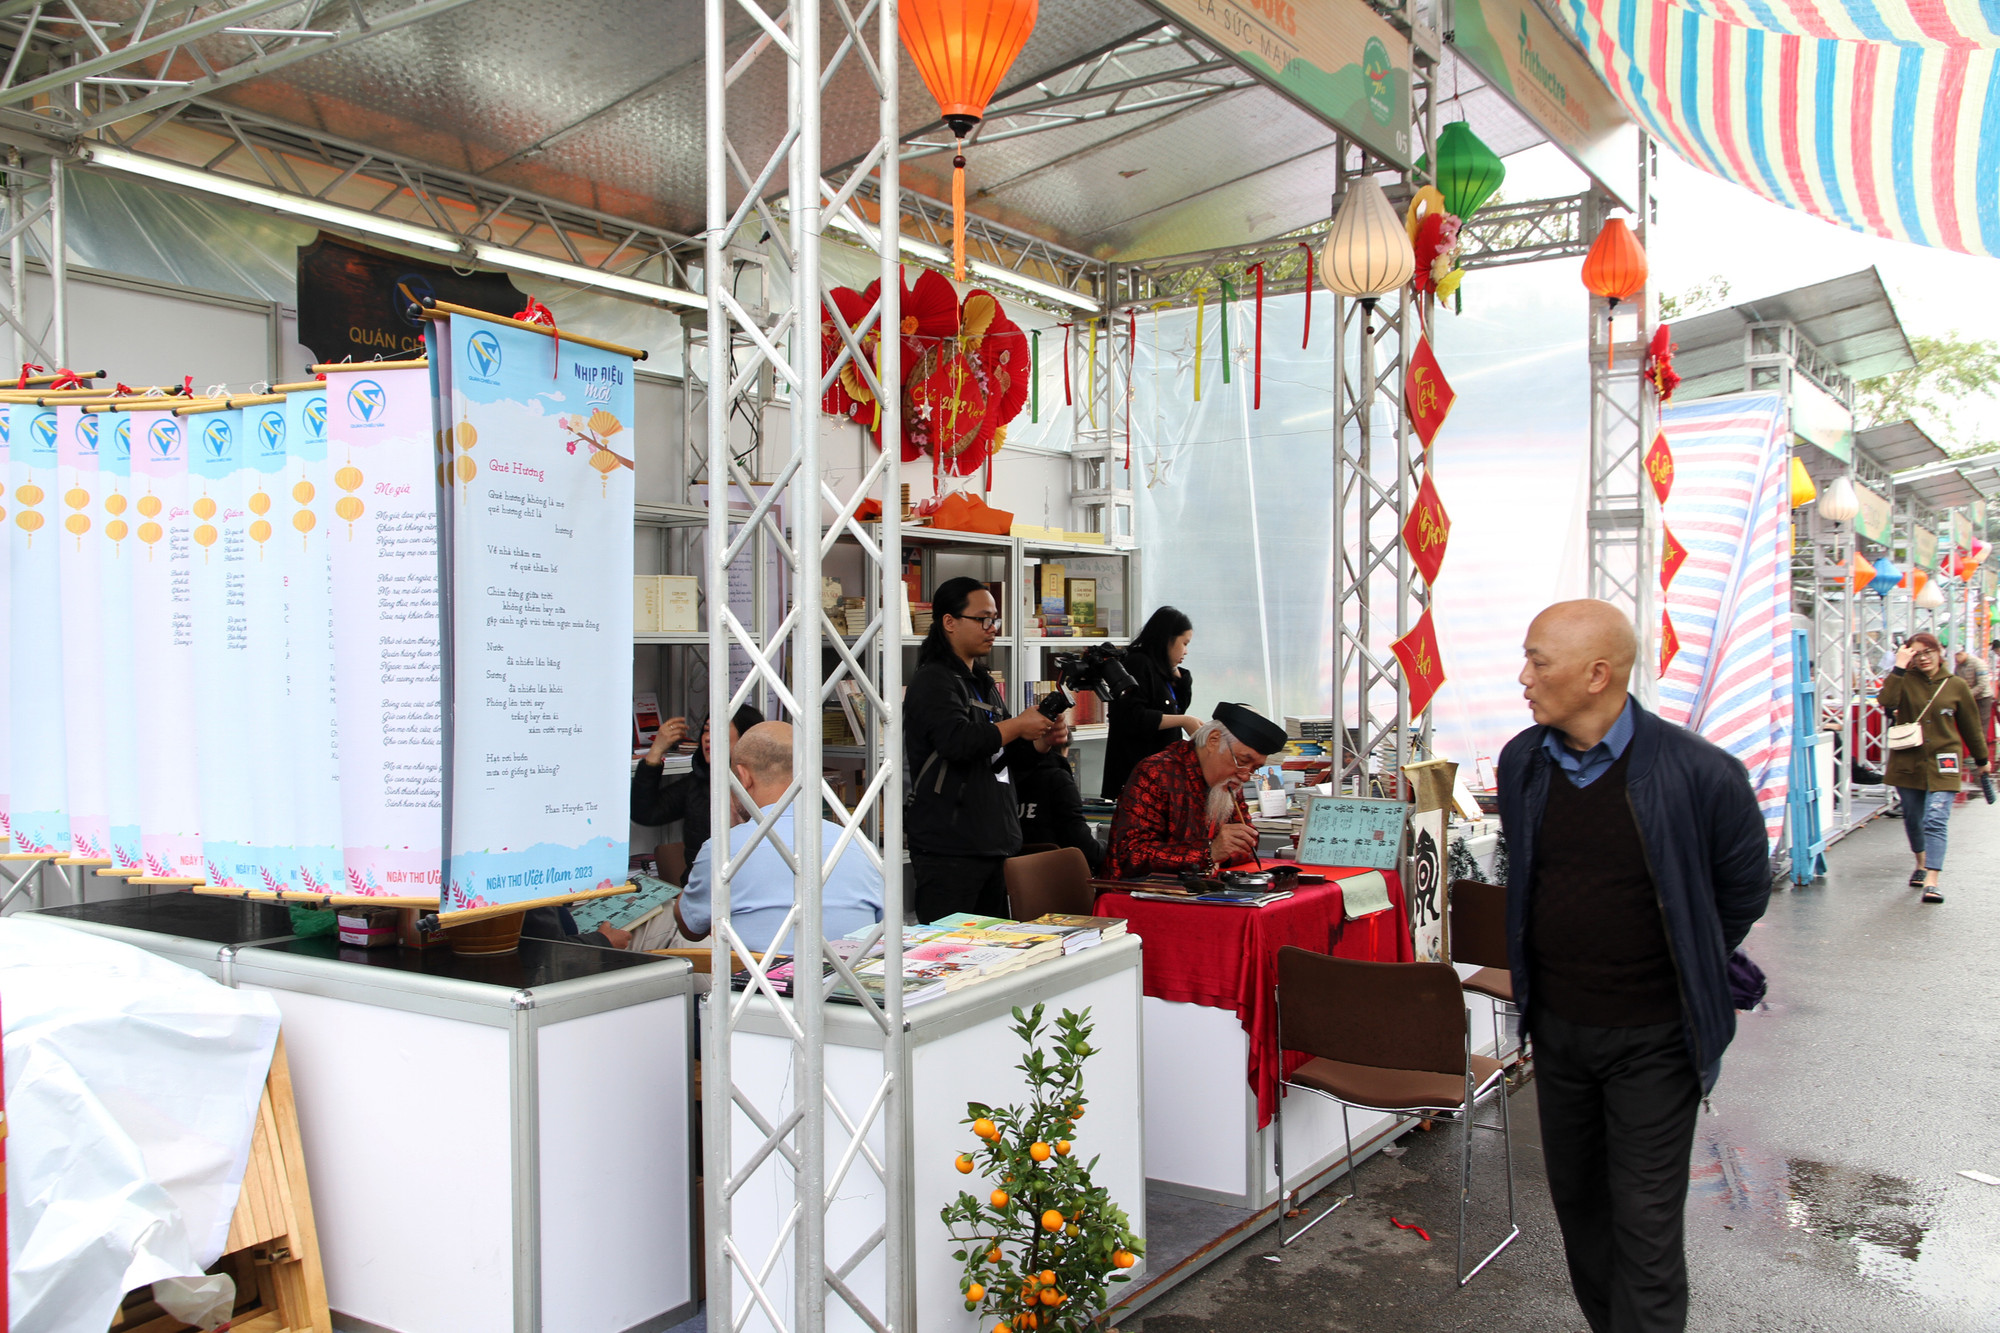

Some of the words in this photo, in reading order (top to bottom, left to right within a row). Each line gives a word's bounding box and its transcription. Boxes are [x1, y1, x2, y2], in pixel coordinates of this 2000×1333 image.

[350, 326, 396, 349] QUÁN
[575, 363, 598, 384] NHỊP
[601, 365, 623, 385] ĐIỆU
[489, 459, 509, 472] Quê
[512, 462, 544, 482] Hương
[488, 490, 503, 499] Quê
[487, 586, 506, 596] Chim
[545, 804, 560, 814] Phan
[387, 870, 407, 883] NGÀY
[410, 871, 424, 883] THƠ
[487, 875, 505, 890] NGÀY
[508, 875, 522, 888] THƠ
[524, 870, 544, 890] Việt
[546, 868, 572, 883] Nam
[575, 866, 592, 879] 2023
